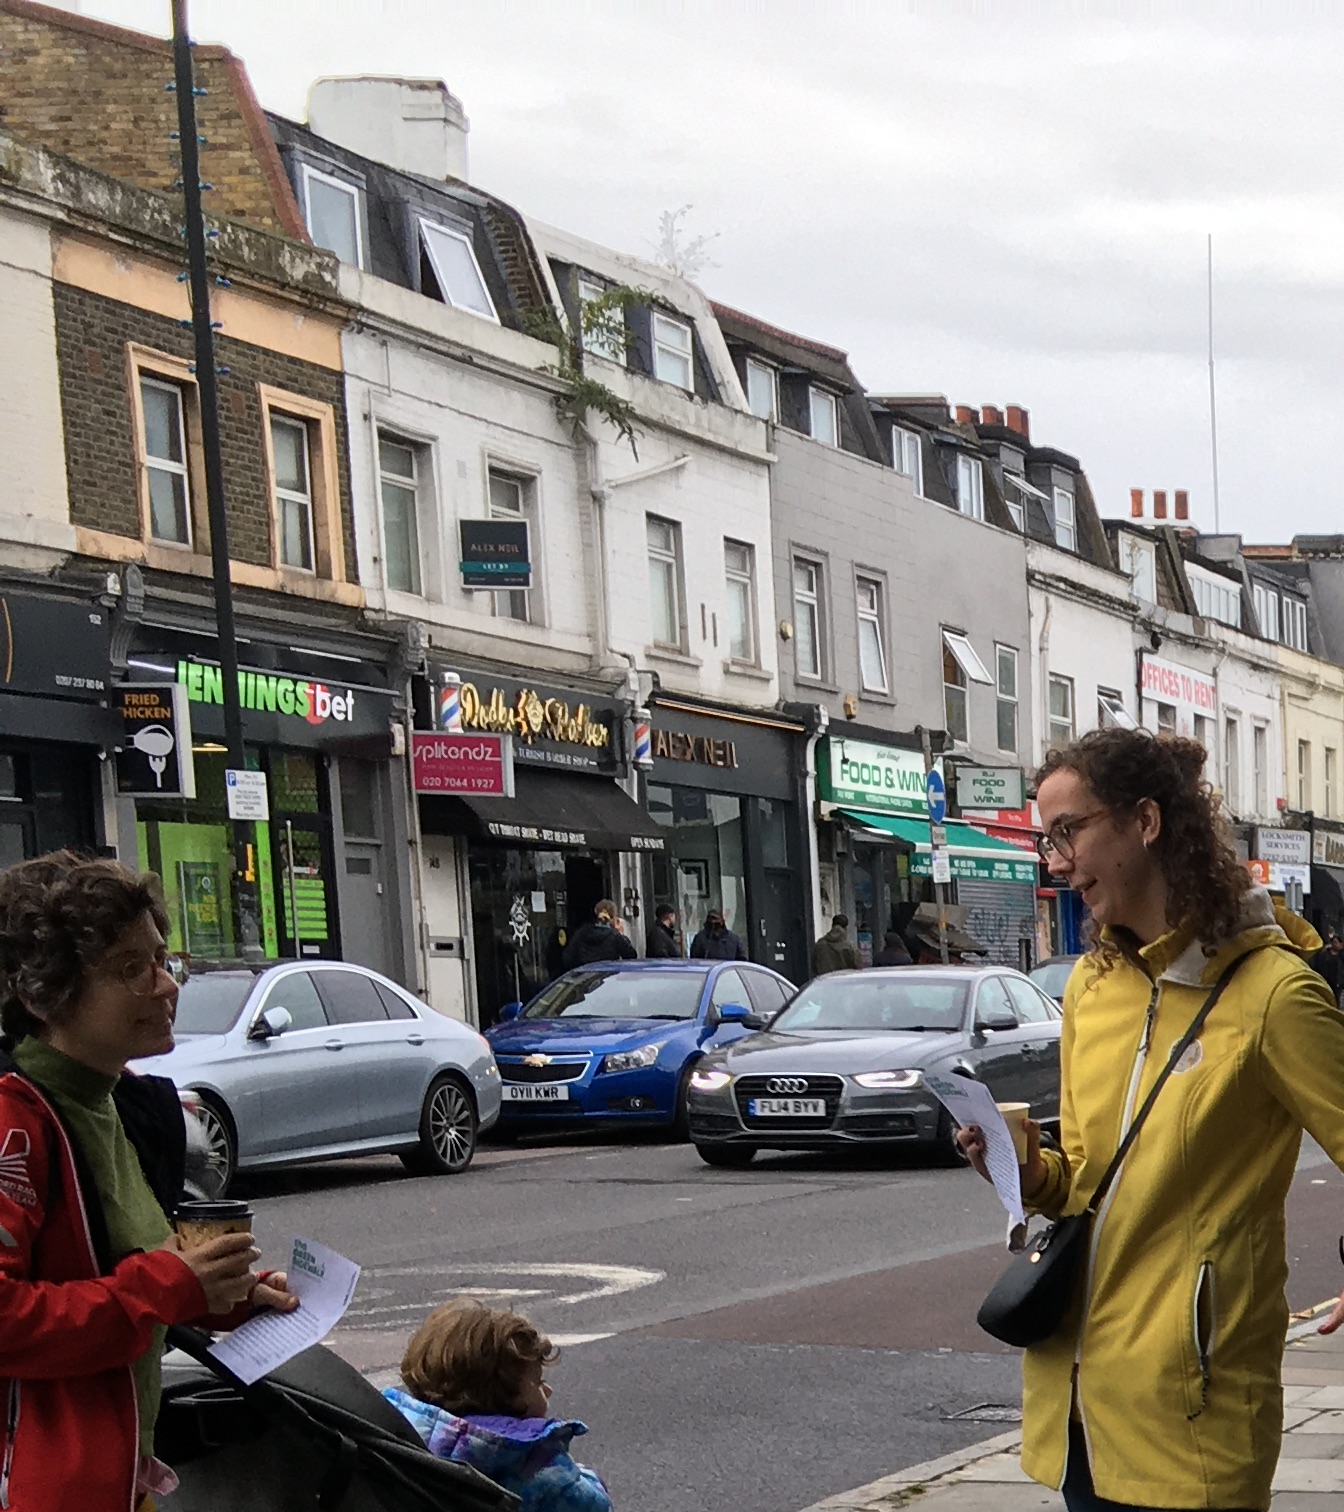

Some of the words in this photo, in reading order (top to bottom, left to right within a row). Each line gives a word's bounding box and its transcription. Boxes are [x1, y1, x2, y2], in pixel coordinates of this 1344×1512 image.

[124, 693, 160, 706] FRIED
[121, 706, 172, 719] HICKEN
[413, 741, 502, 762] splitendz
[422, 777, 442, 787] 020
[471, 778, 495, 788] 1927
[841, 761, 882, 787] FOOD
[884, 766, 896, 789] &
[896, 768, 928, 794] WIN
[972, 778, 1006, 788] FOOD
[973, 795, 1006, 804] WINE
[1261, 831, 1306, 842] LOCKSMITH
[1265, 841, 1301, 851] SERVICES
[535, 1086, 559, 1098] KWR
